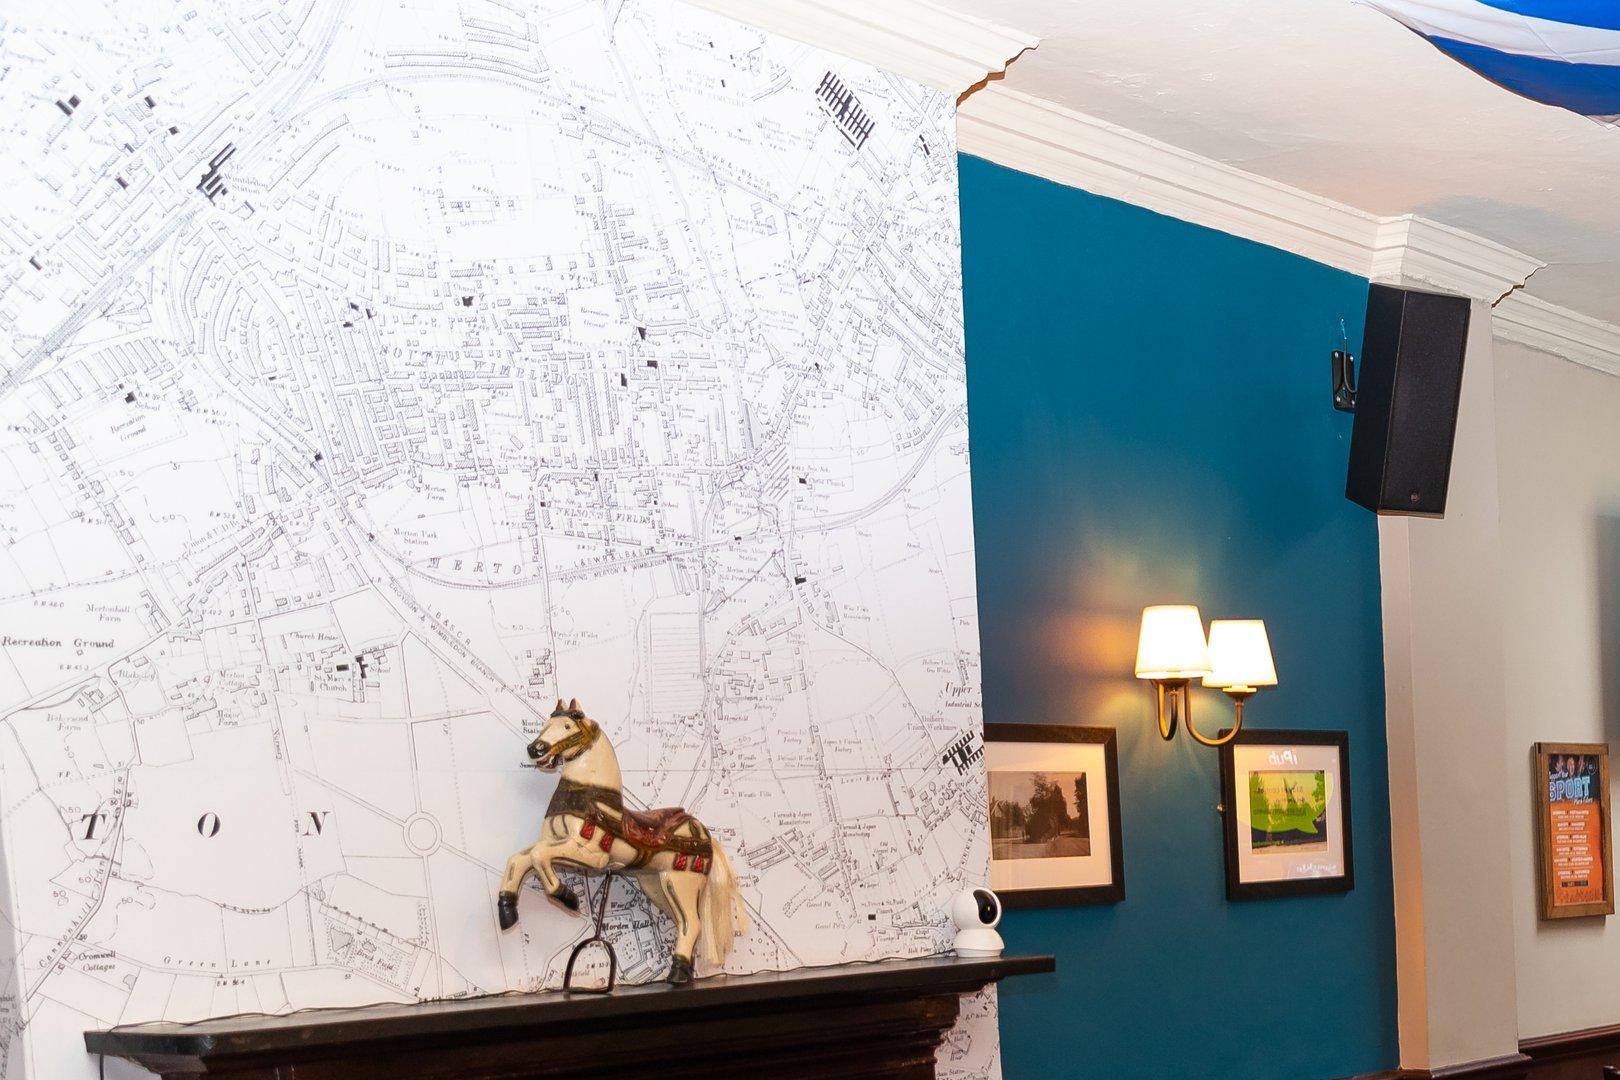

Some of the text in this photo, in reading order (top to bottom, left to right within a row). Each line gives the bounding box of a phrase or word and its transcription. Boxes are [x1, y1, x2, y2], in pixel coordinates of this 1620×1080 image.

[98, 615, 122, 623] Farm
[1, 635, 115, 649] Recreation Ground
[430, 623, 467, 659] WIMBLEDON
[319, 683, 347, 693] Church
[945, 681, 973, 699] Upper
[1549, 776, 1591, 802] SPORT
[78, 950, 117, 961] Cromwell
[163, 955, 271, 969] Green Lane
[356, 948, 397, 971] Brick Field
[82, 963, 116, 972] Cottages
